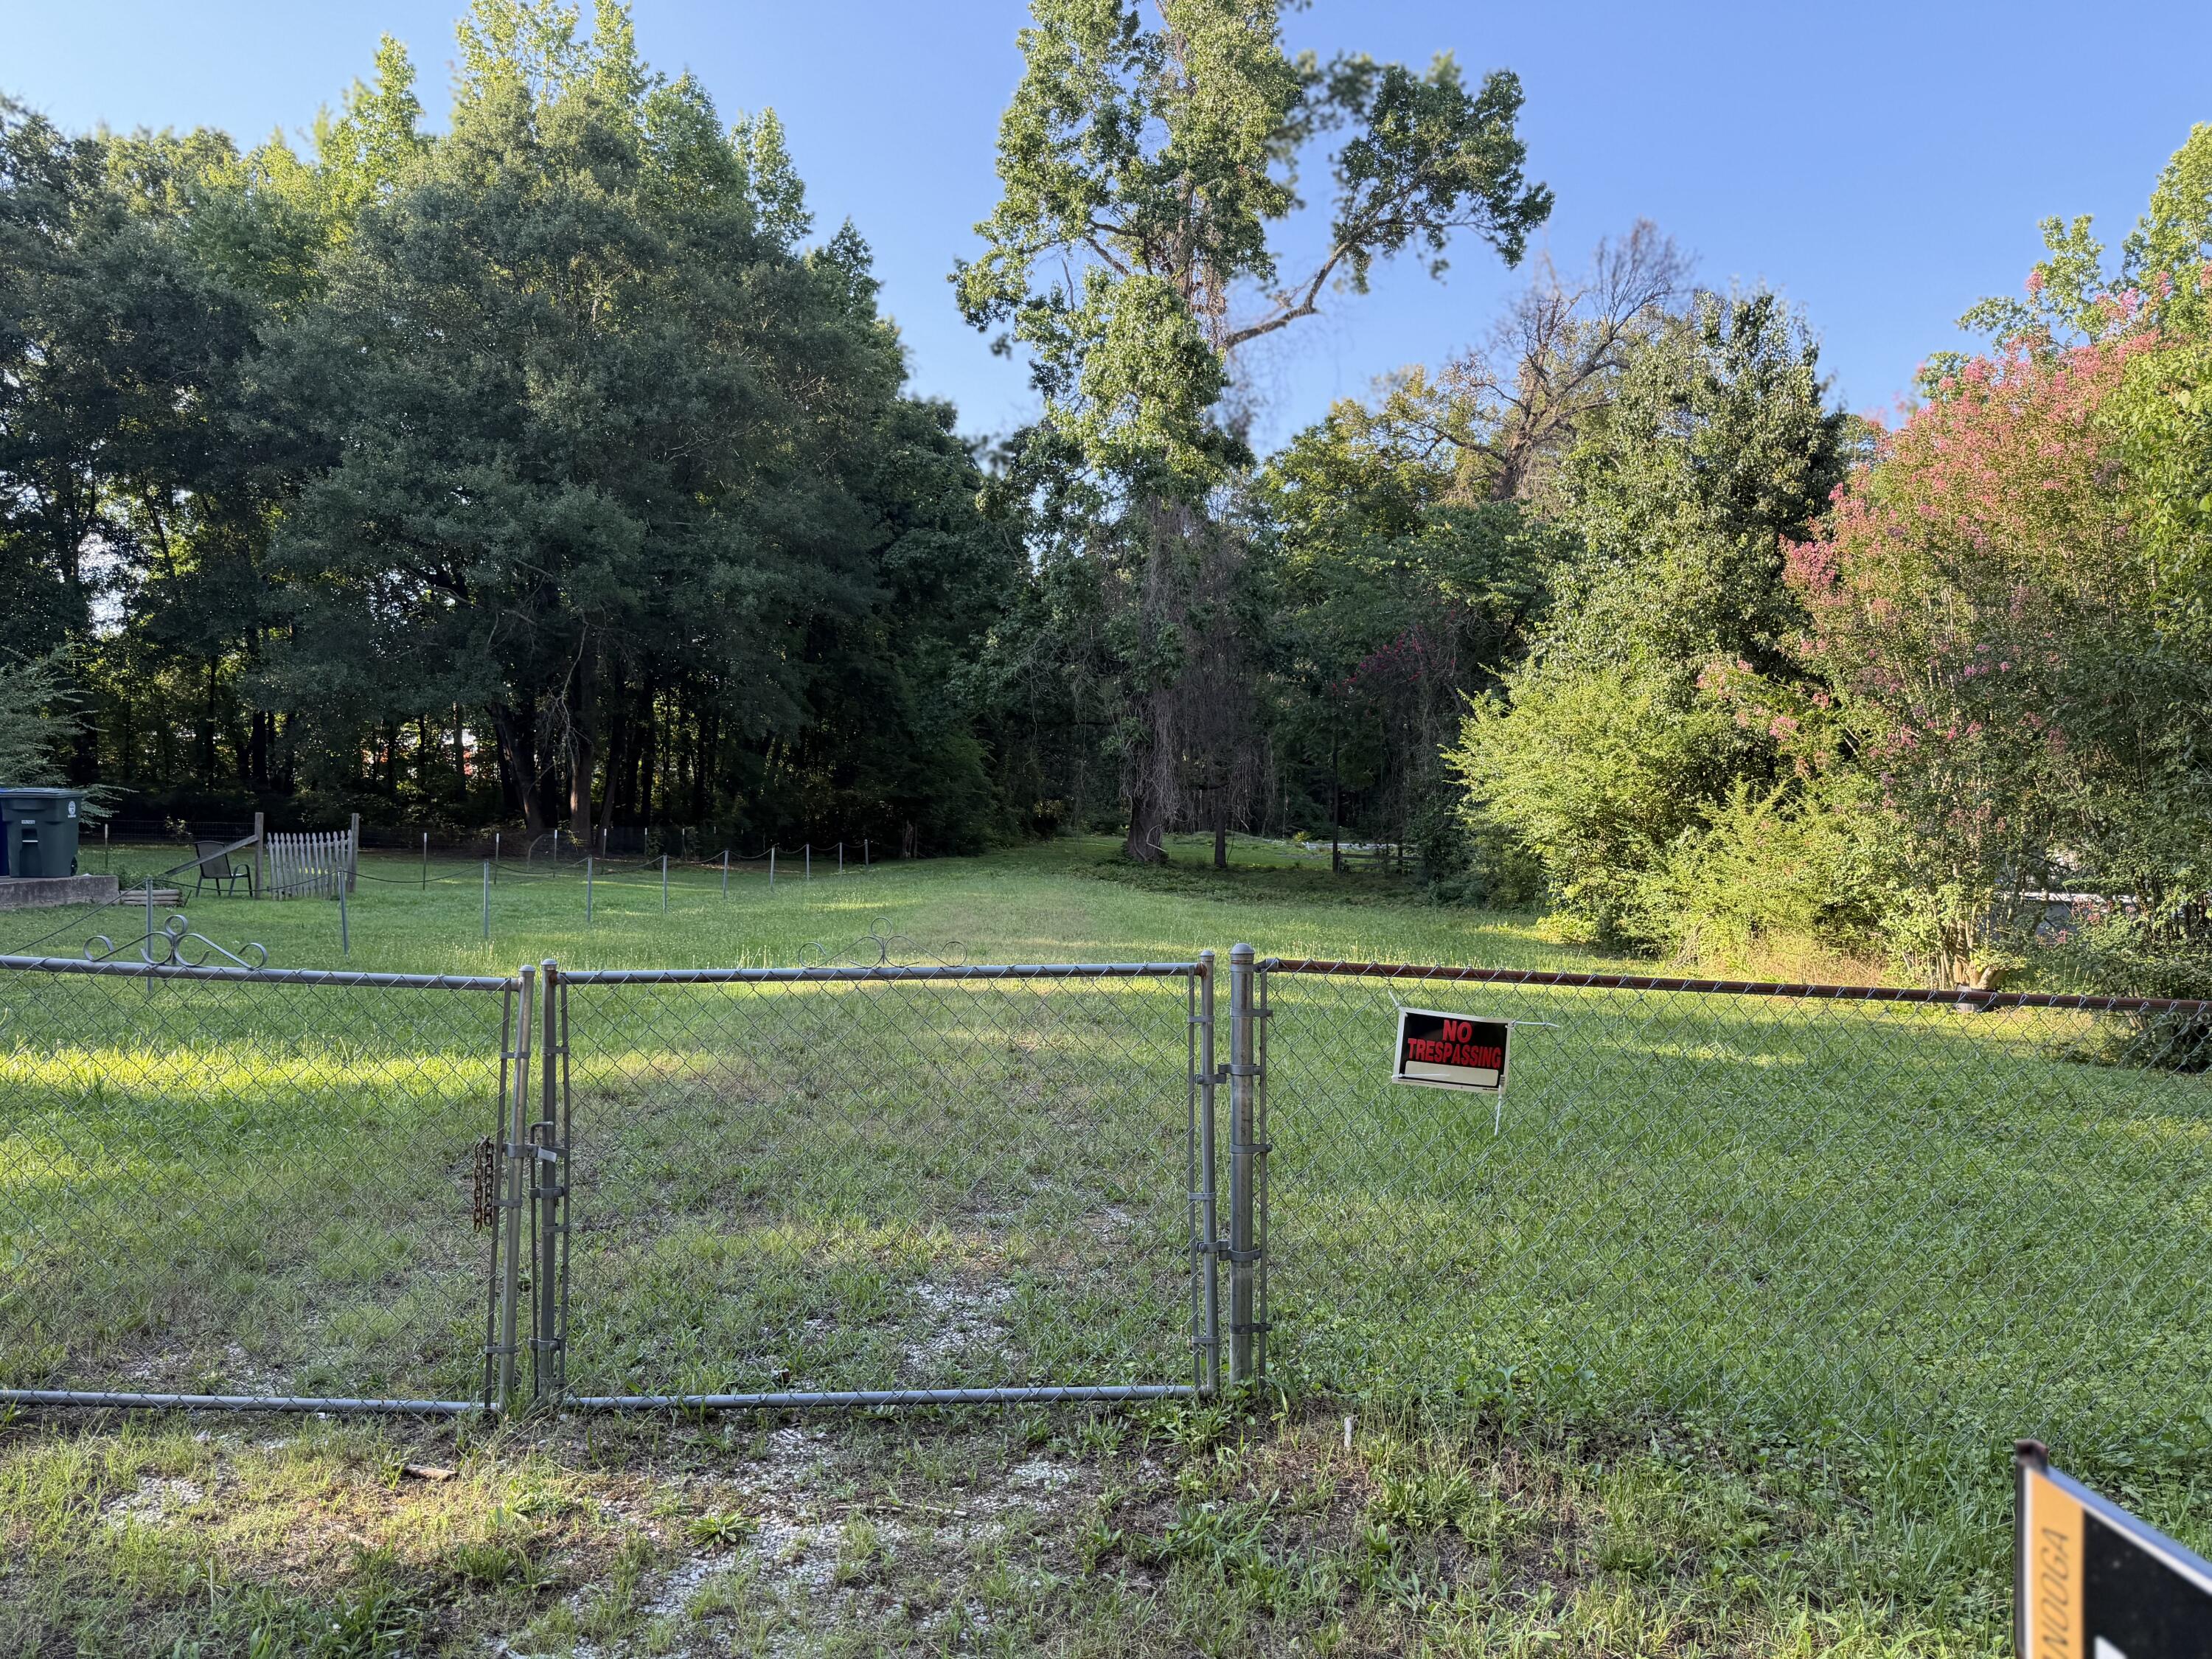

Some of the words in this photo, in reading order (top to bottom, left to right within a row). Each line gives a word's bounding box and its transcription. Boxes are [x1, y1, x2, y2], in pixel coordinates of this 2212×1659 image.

[1442, 1019, 1473, 1043] NO
[1408, 1037, 1502, 1068] TRESPASSING
[2041, 1527, 2070, 1659] NOOGA
